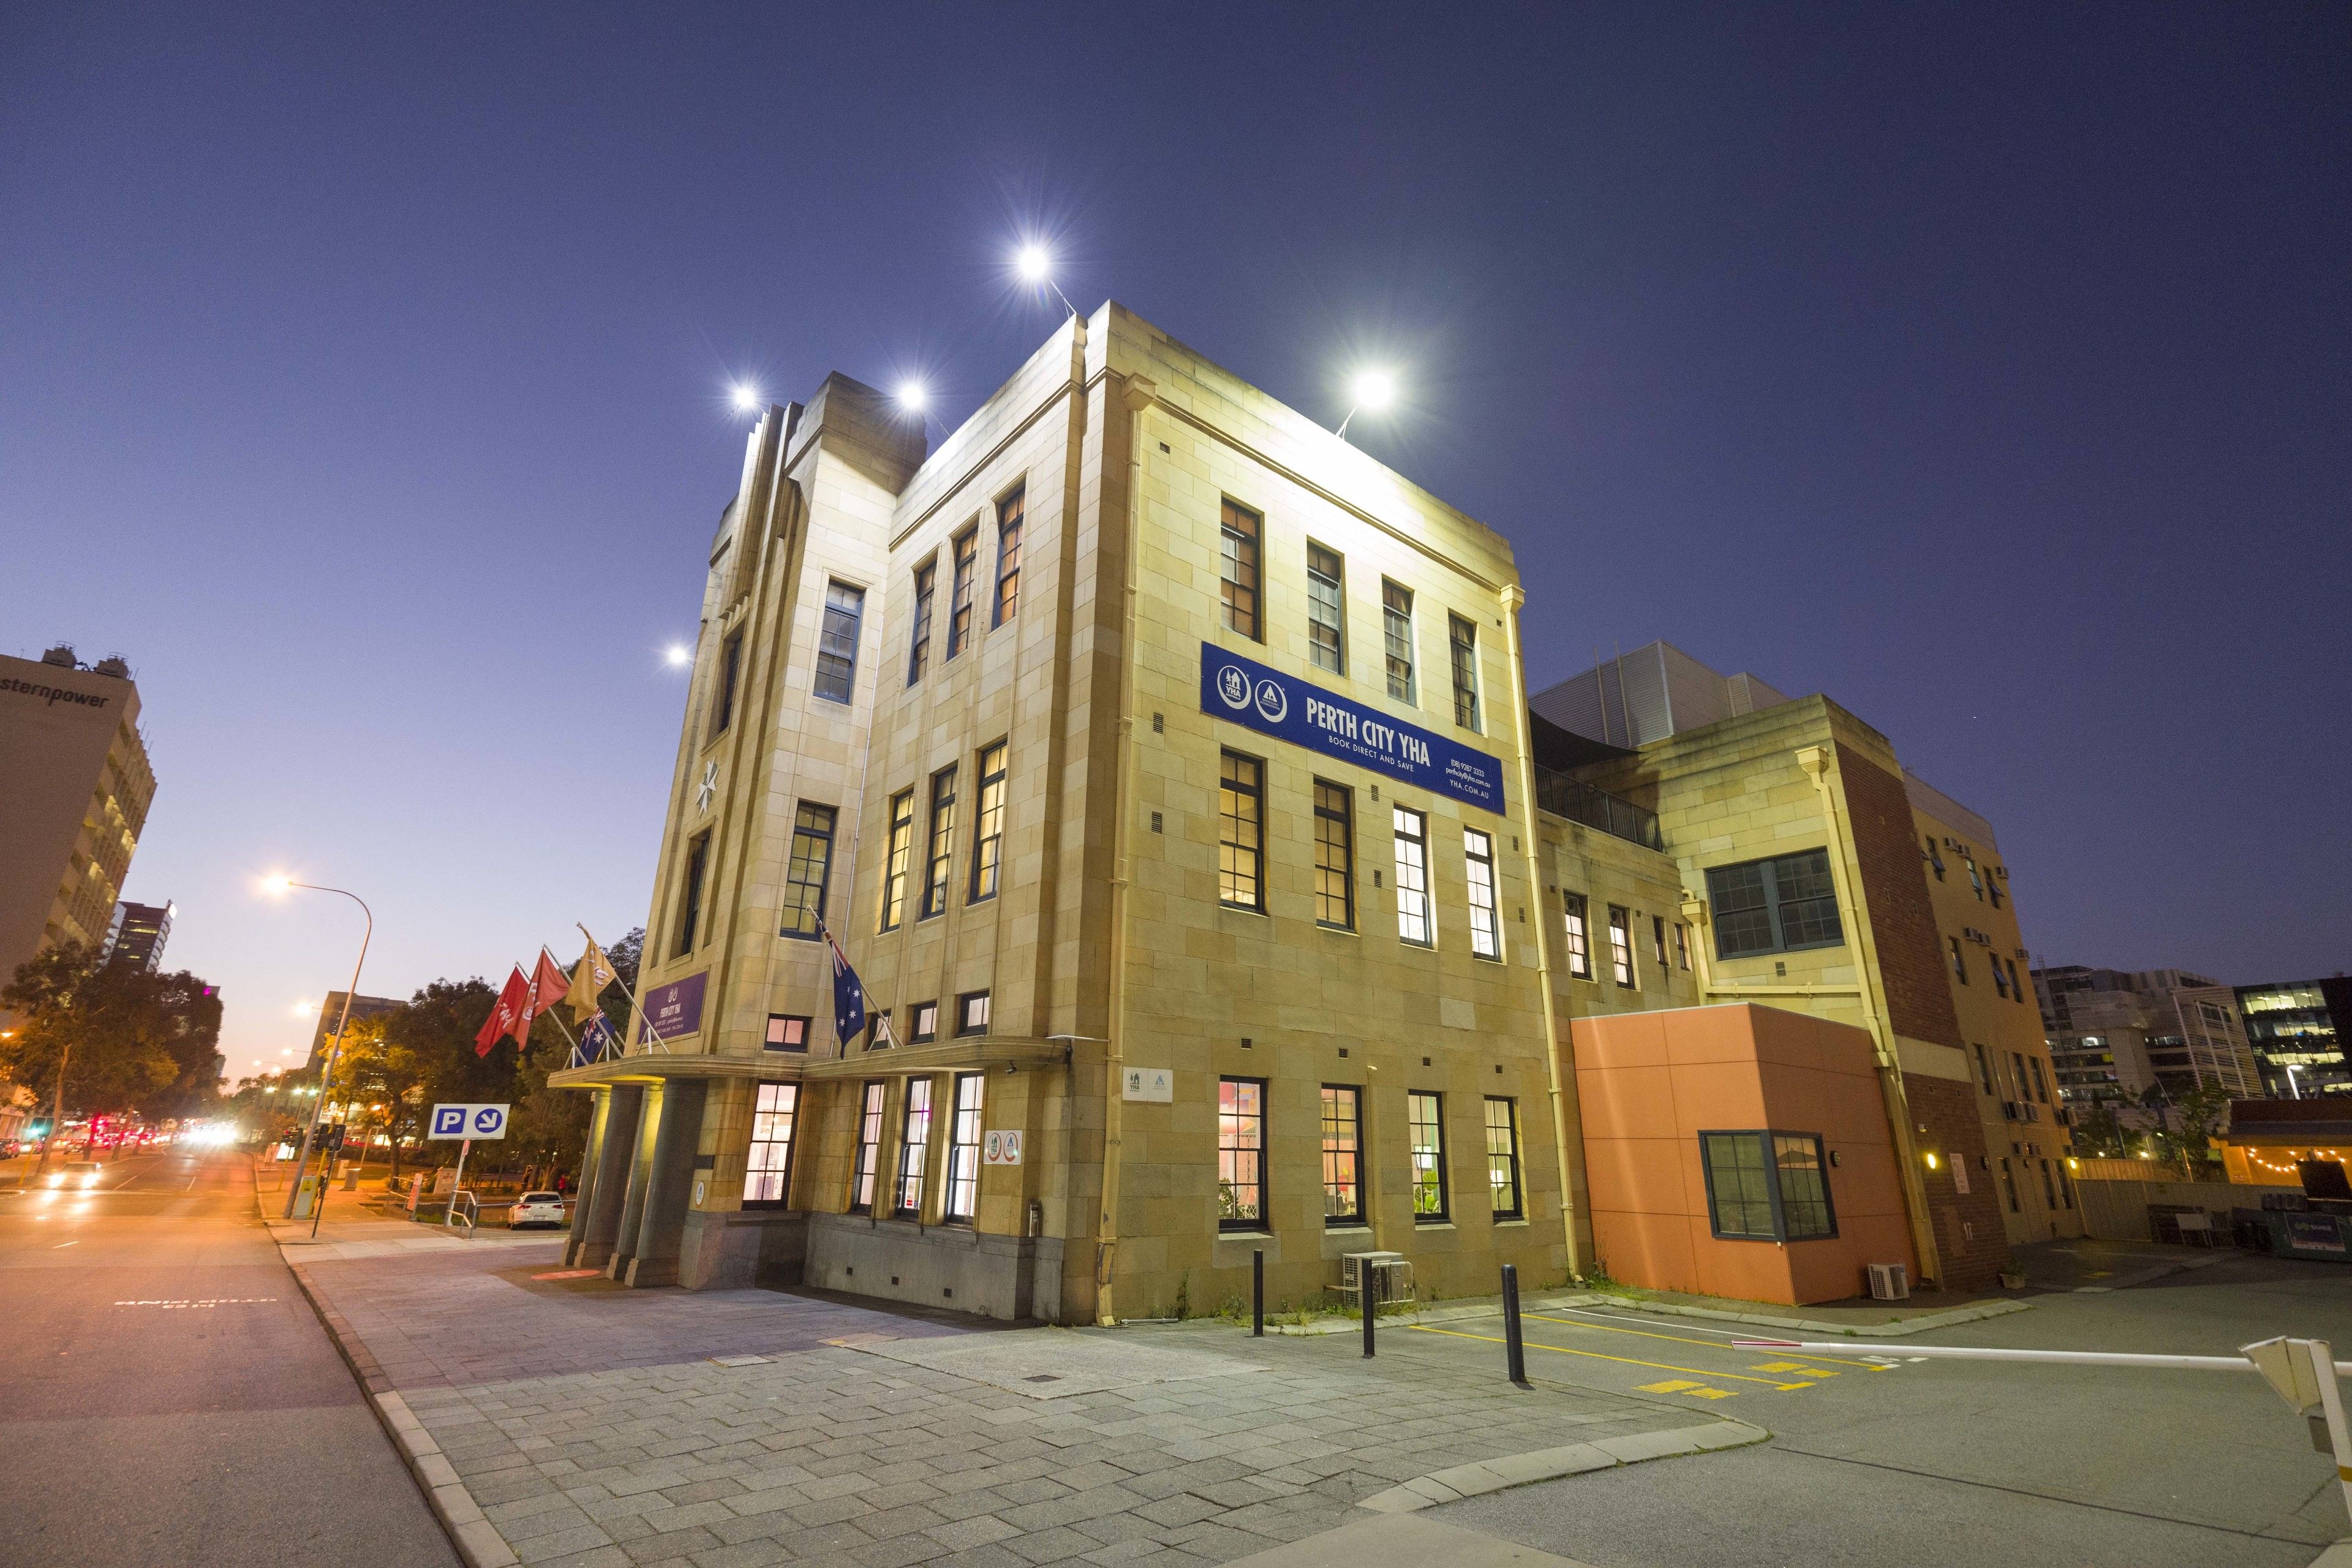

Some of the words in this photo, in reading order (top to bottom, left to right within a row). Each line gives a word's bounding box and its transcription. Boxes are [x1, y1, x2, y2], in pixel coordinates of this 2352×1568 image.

[1226, 685, 1241, 697] YHA
[1307, 697, 1357, 739] PERTH
[1362, 720, 1394, 753] CITY
[1398, 733, 1431, 767] YHA
[1329, 735, 1350, 749] BOOK
[1353, 744, 1377, 758] DIRECT
[1379, 755, 1395, 765] AND
[1397, 760, 1414, 772] SAVE
[1446, 767, 1490, 788] perthcity@yha.com.au
[1451, 759, 1460, 769] (08)
[1461, 763, 1472, 772] 9287
[1473, 767, 1484, 777] 3333
[1450, 779, 1489, 799] YHA.COM.AU
[441, 1112, 461, 1131] P
